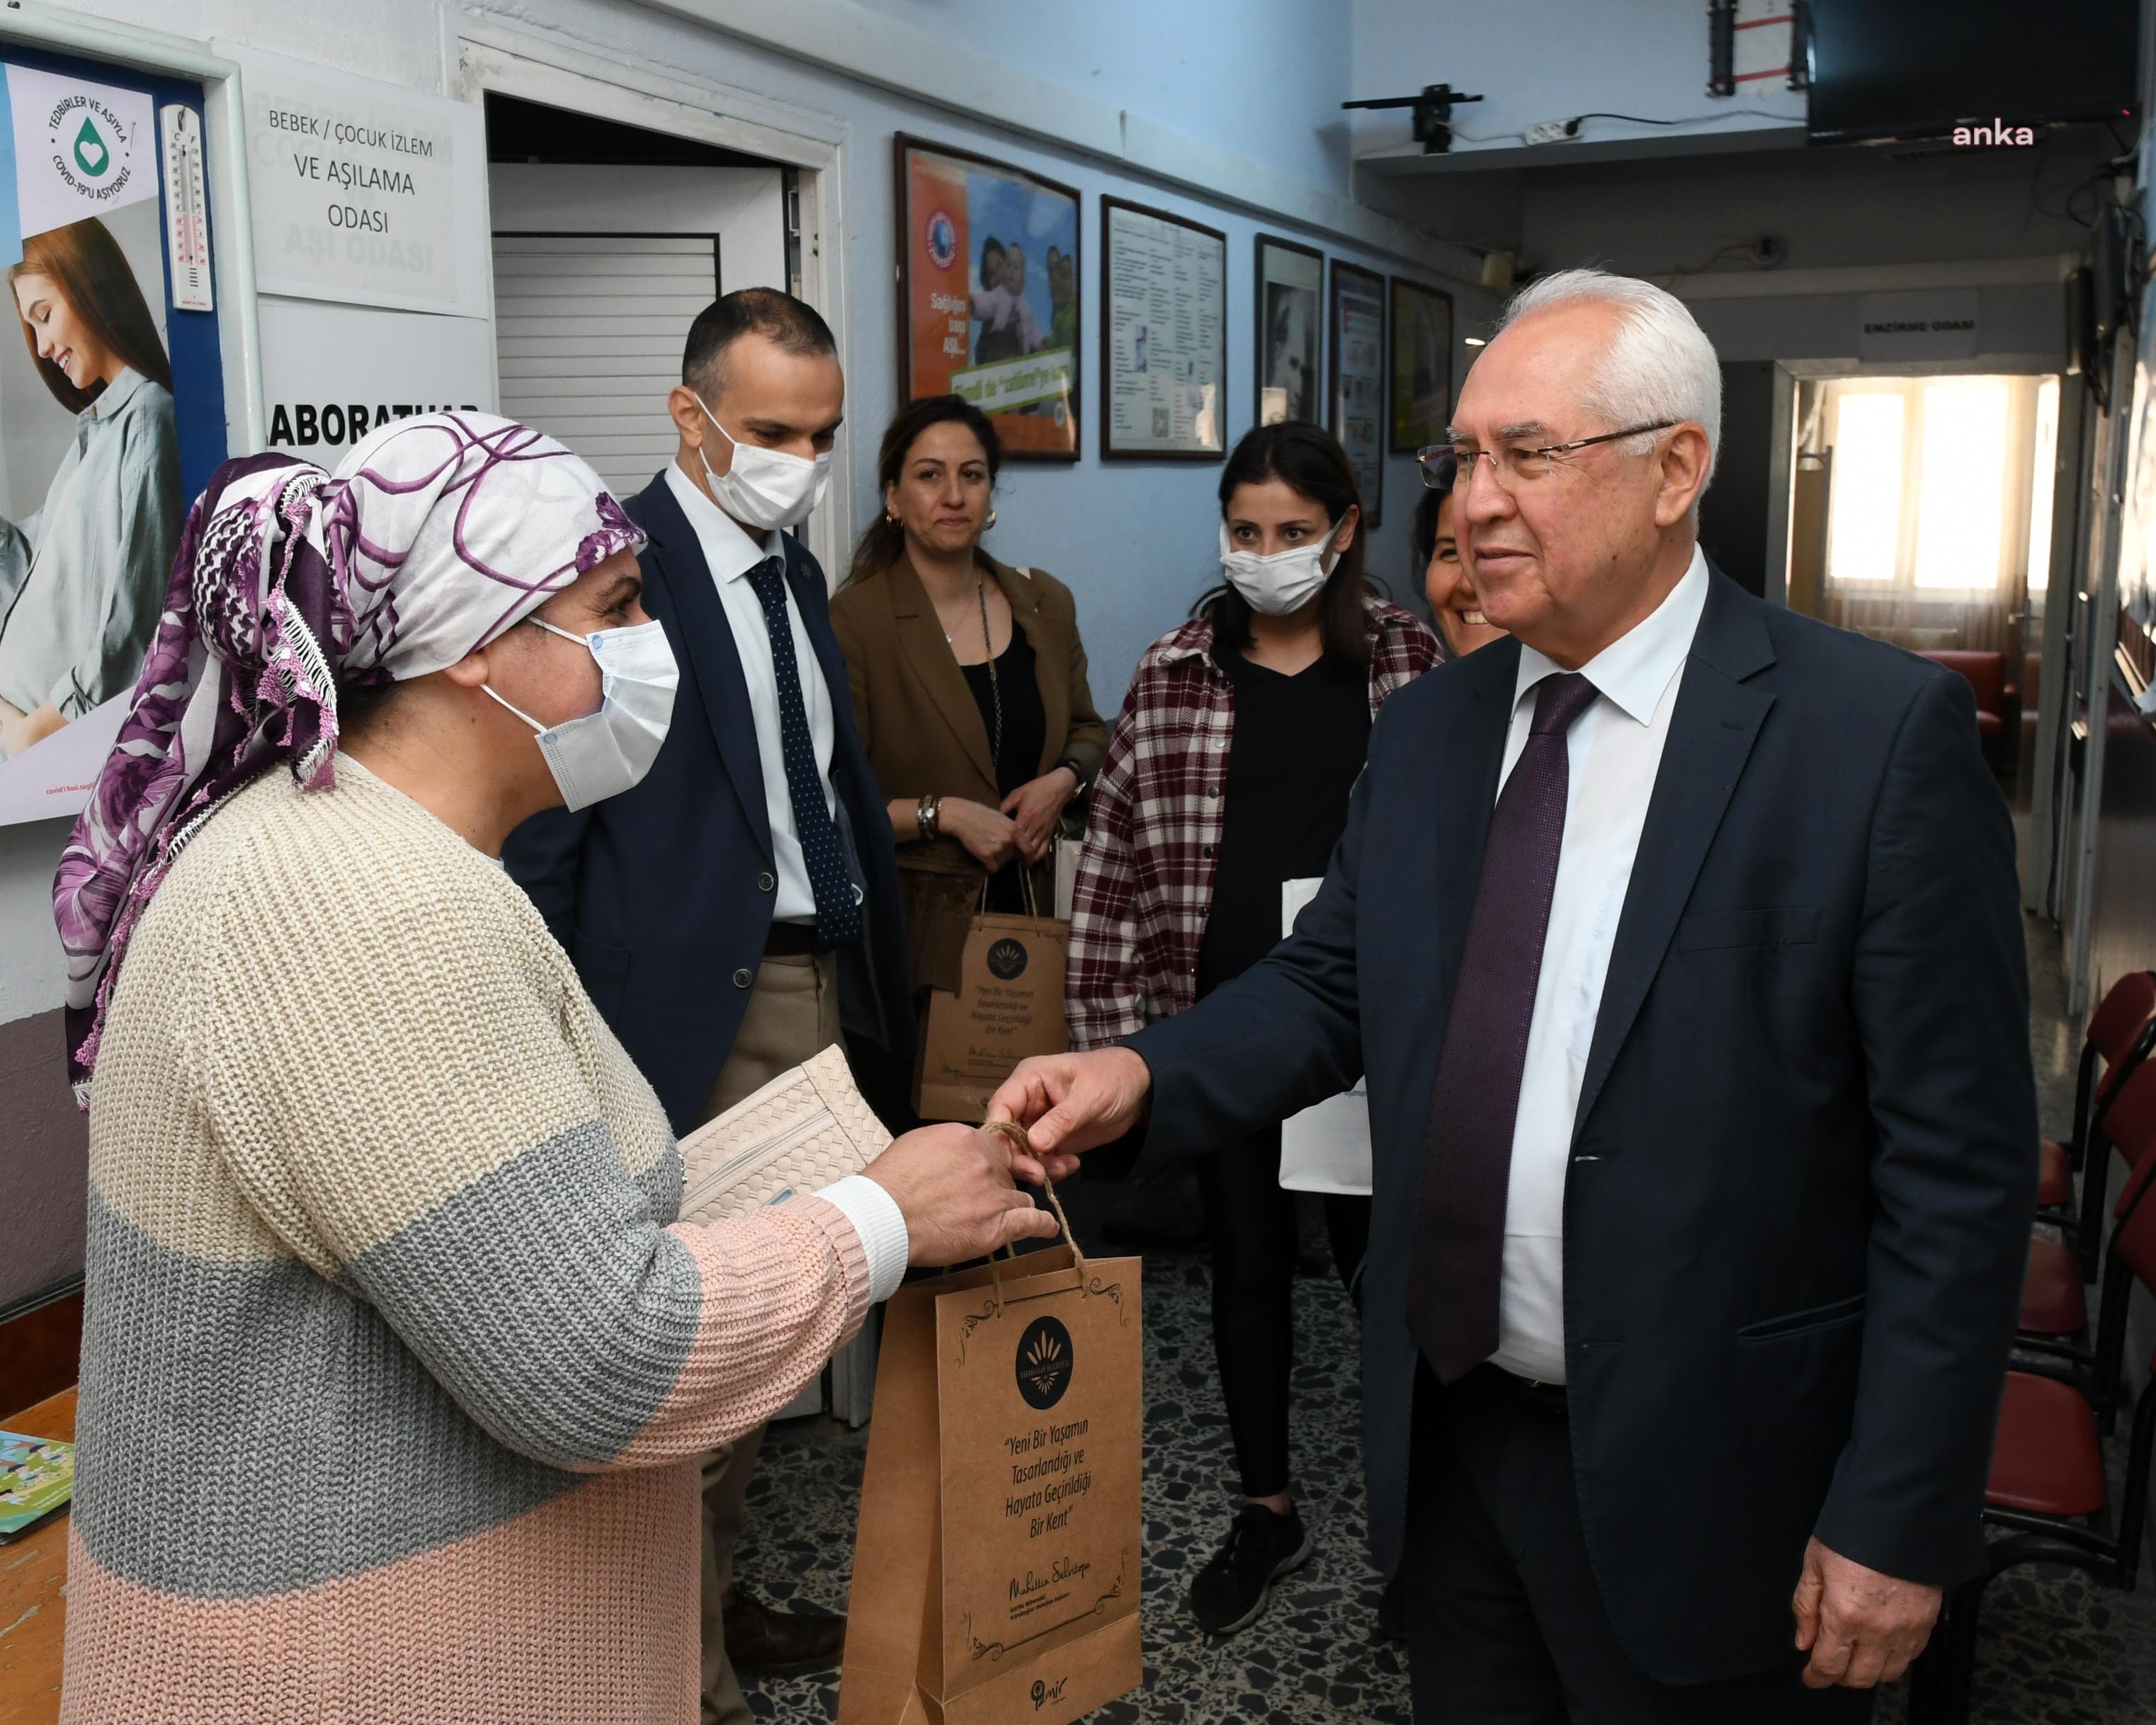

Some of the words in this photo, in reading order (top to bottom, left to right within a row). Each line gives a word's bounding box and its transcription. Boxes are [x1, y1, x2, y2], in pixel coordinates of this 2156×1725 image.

[49, 96, 87, 130] TEDBİRLER
[89, 98, 101, 113] VE
[101, 108, 127, 143] AŞIYLA
[269, 110, 319, 136] BEBEK
[323, 120, 330, 140] /
[334, 123, 387, 149] ÇOCUK
[391, 130, 433, 156] İZLEM
[96, 166, 131, 200] AŞIYORUZ
[294, 154, 320, 180] VE
[327, 161, 415, 195] AŞILAMA
[328, 205, 388, 234] ODASI
[1033, 1426, 1048, 1447] Bir
[1050, 1418, 1089, 1445] Yaşamın
[1012, 1449, 1072, 1485] Tasarlandığı
[1074, 1448, 1084, 1464] ve
[1006, 1490, 1042, 1518] Hayata
[1044, 1471, 1091, 1505] Geçirildiği
[1030, 1518, 1045, 1538] Bir
